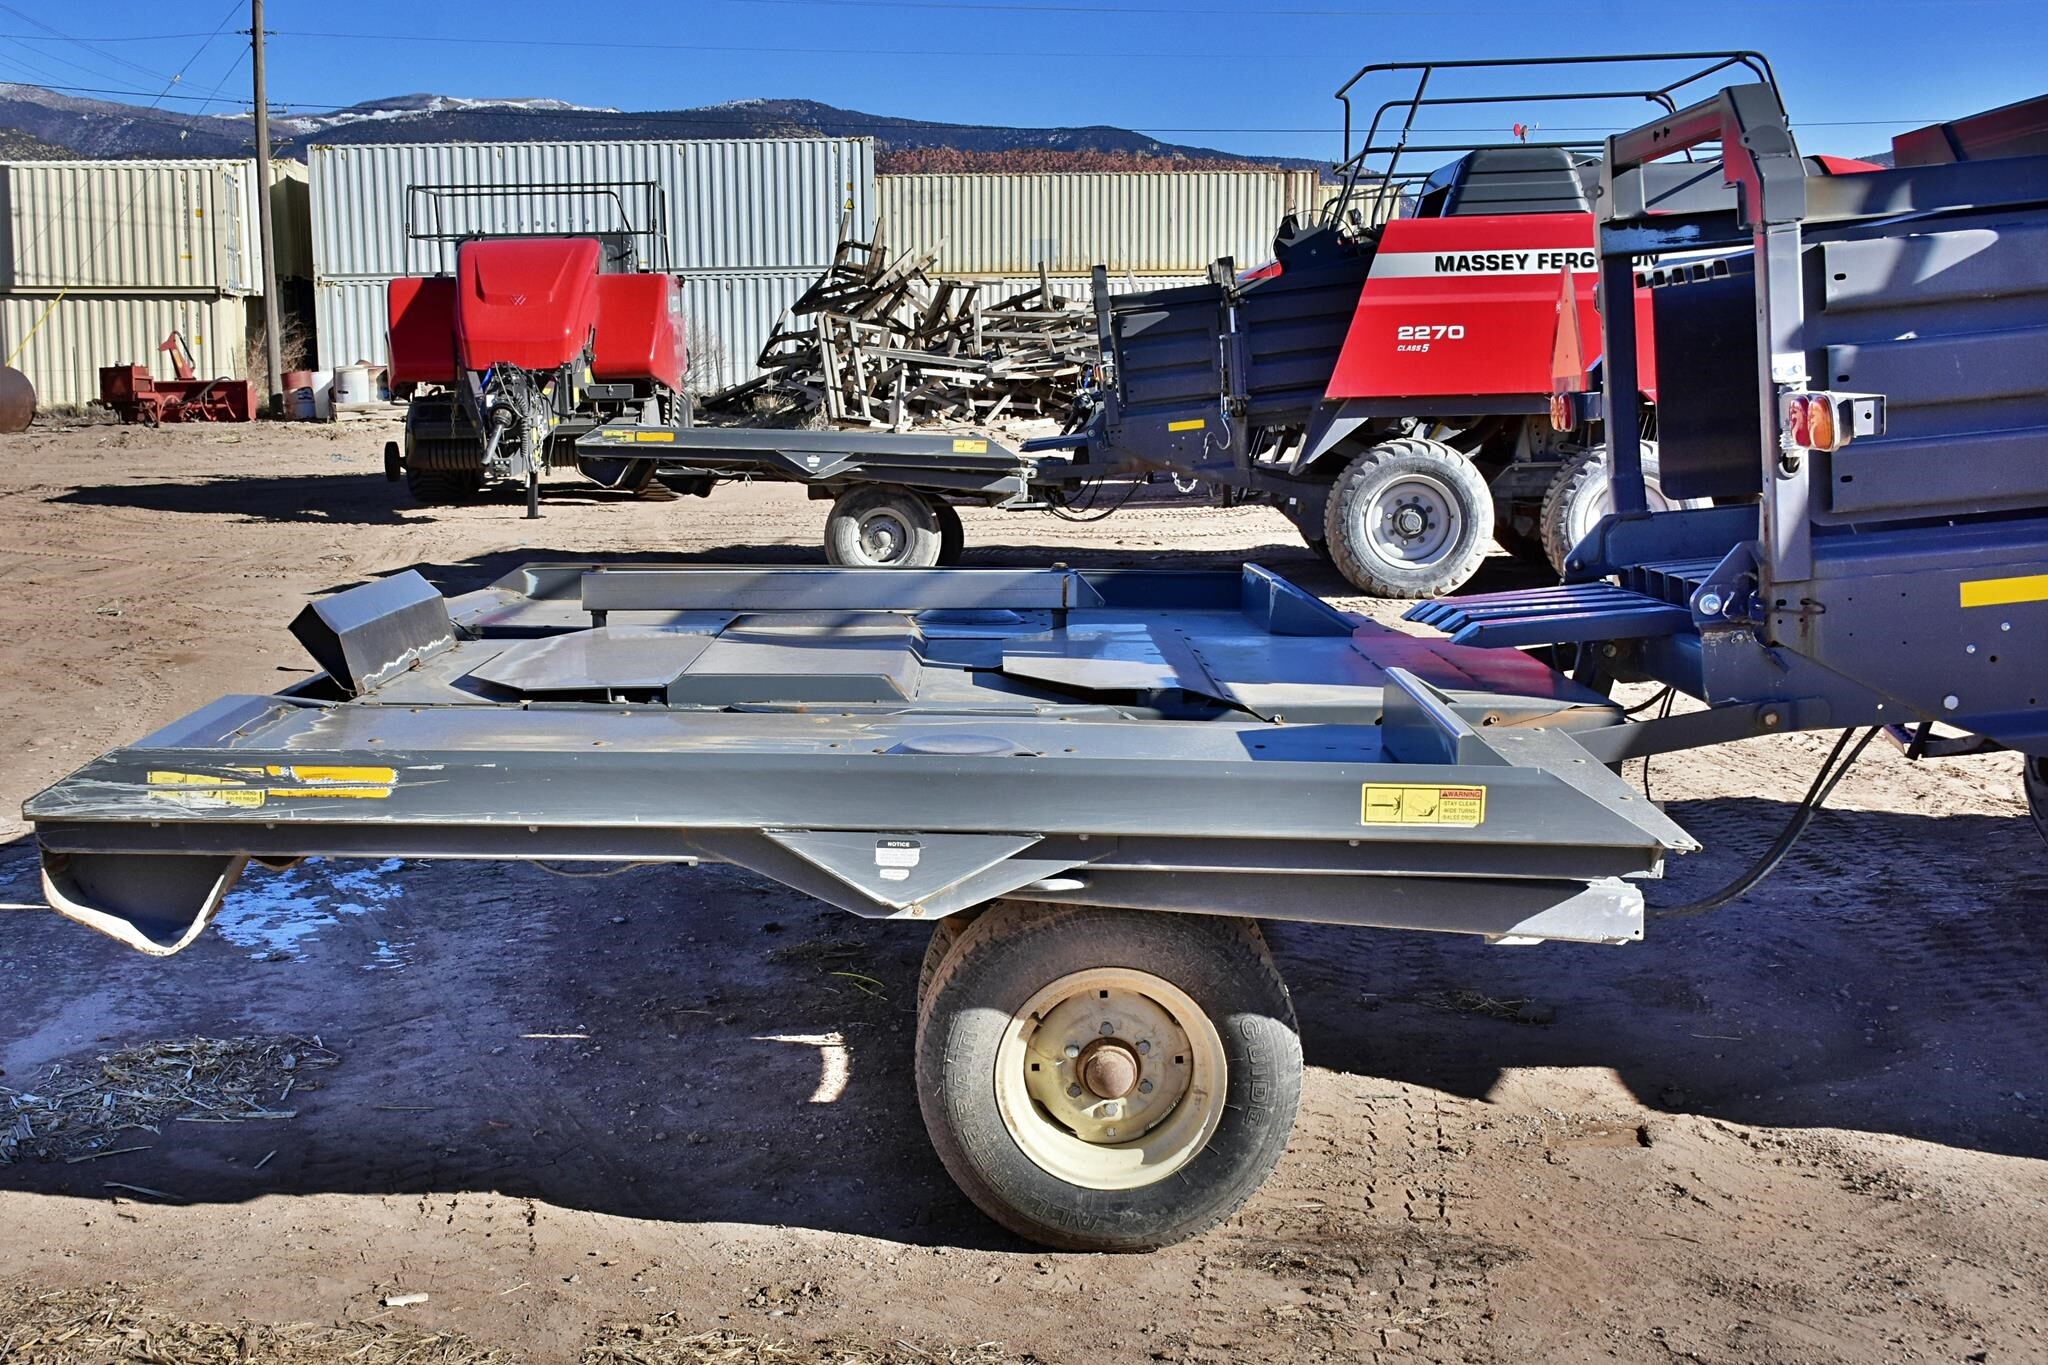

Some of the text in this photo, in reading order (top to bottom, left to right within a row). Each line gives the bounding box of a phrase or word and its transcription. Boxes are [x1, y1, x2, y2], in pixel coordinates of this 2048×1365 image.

[1434, 253, 1529, 272] MASSEY
[1397, 325, 1465, 340] 2270
[1240, 1017, 1270, 1126] GUIDE
